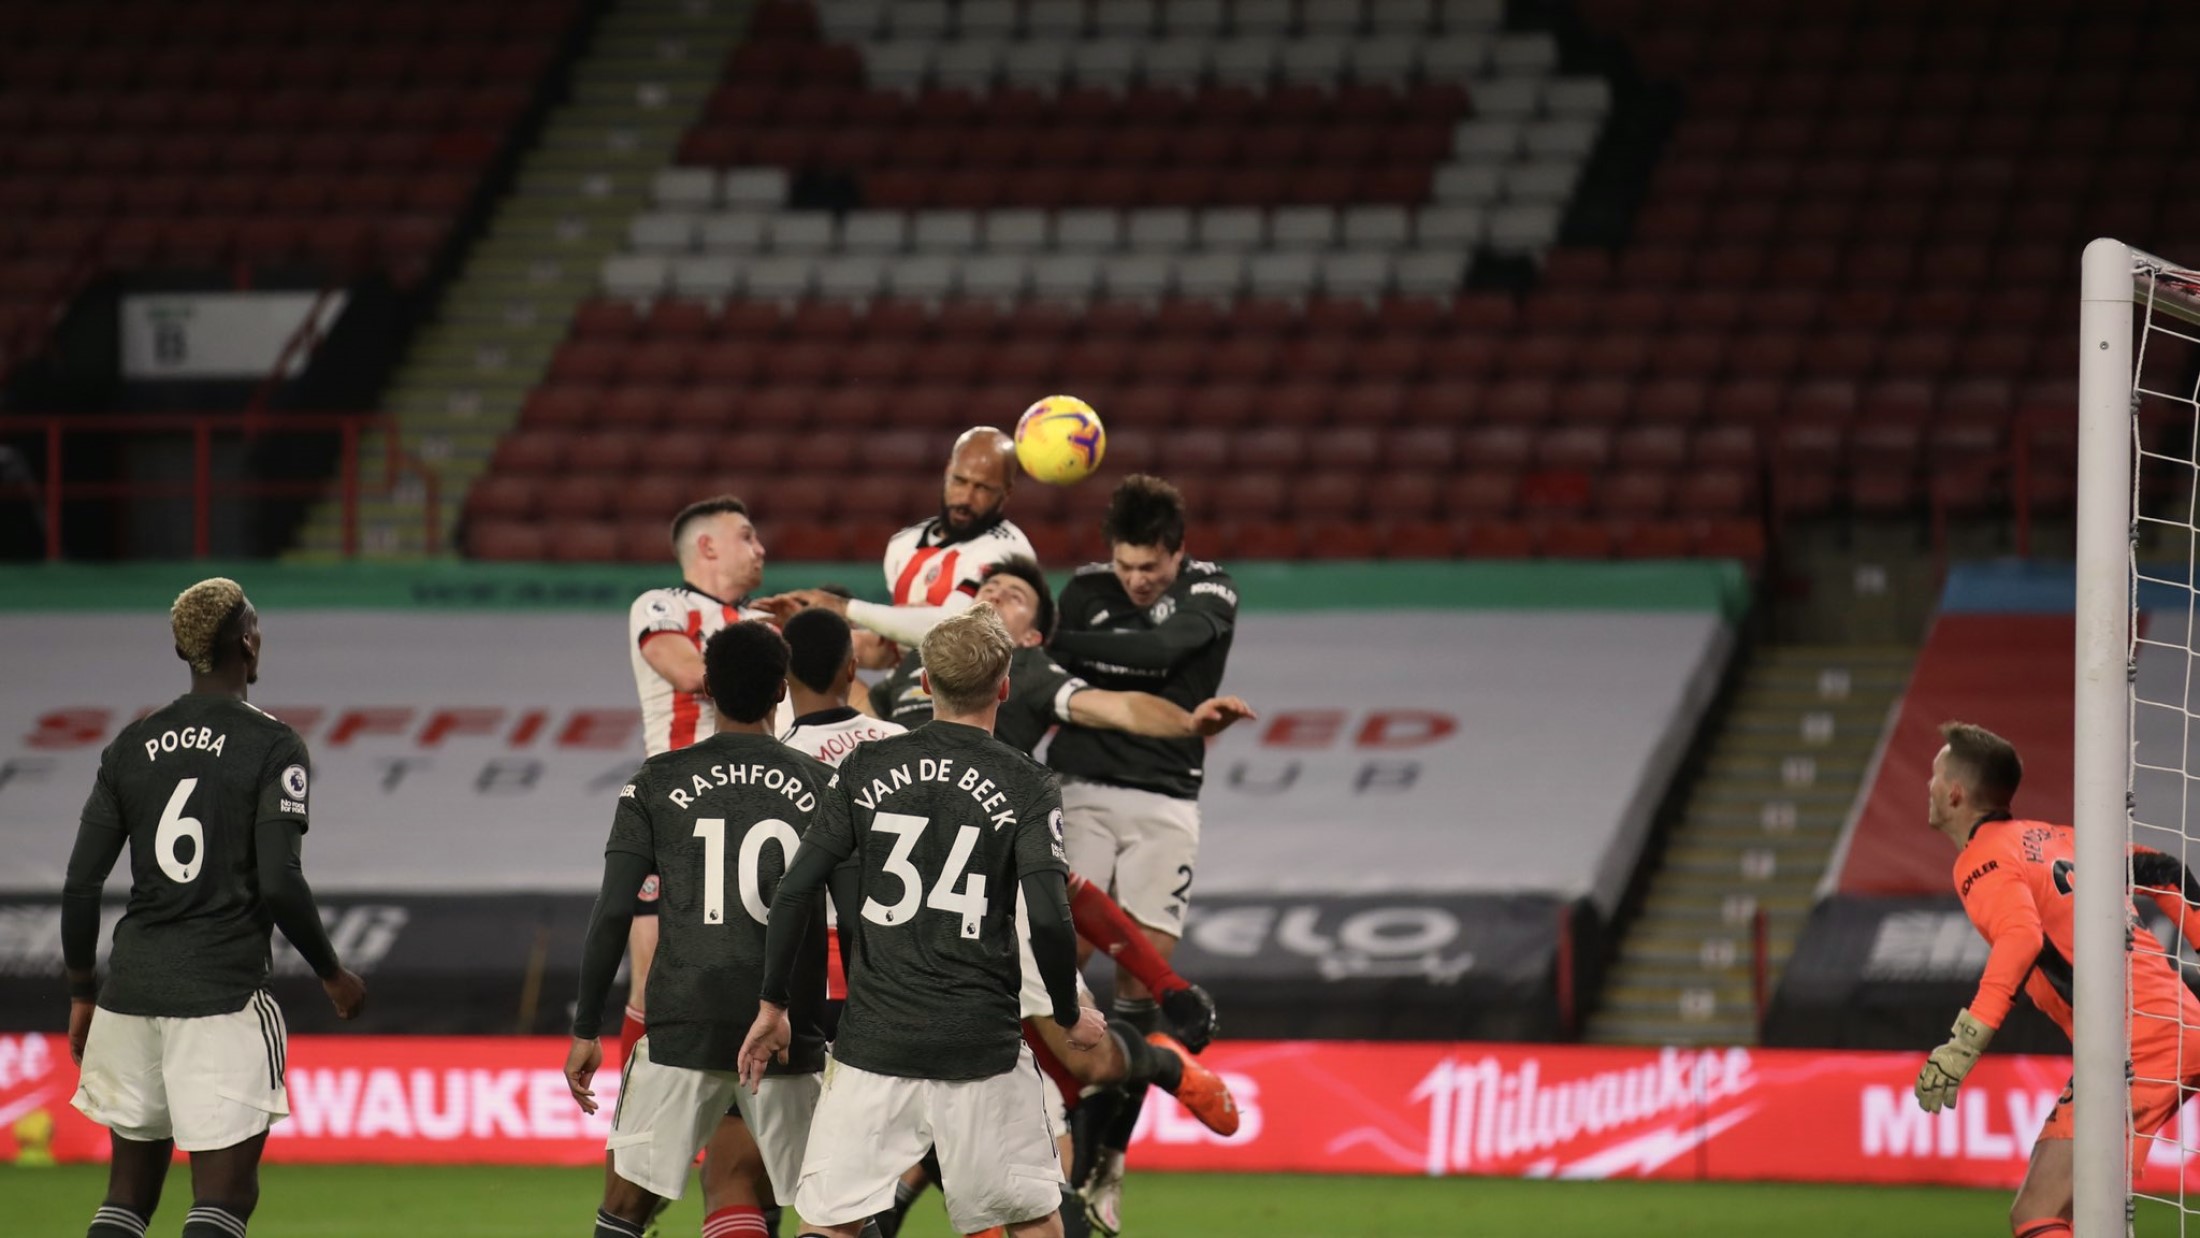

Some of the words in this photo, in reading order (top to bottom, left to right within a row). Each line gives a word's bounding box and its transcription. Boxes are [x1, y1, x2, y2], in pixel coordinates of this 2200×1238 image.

[144, 726, 227, 762] POGBA
[668, 763, 816, 813] RASHFORD
[155, 777, 205, 884] 6
[854, 763, 913, 811] VAN
[919, 758, 954, 783] DE
[957, 767, 1017, 832] BEEK
[692, 818, 801, 926] 10
[860, 811, 989, 940] 34
[1171, 864, 1193, 904] 2
[1405, 1046, 1757, 1175] Milwaukee
